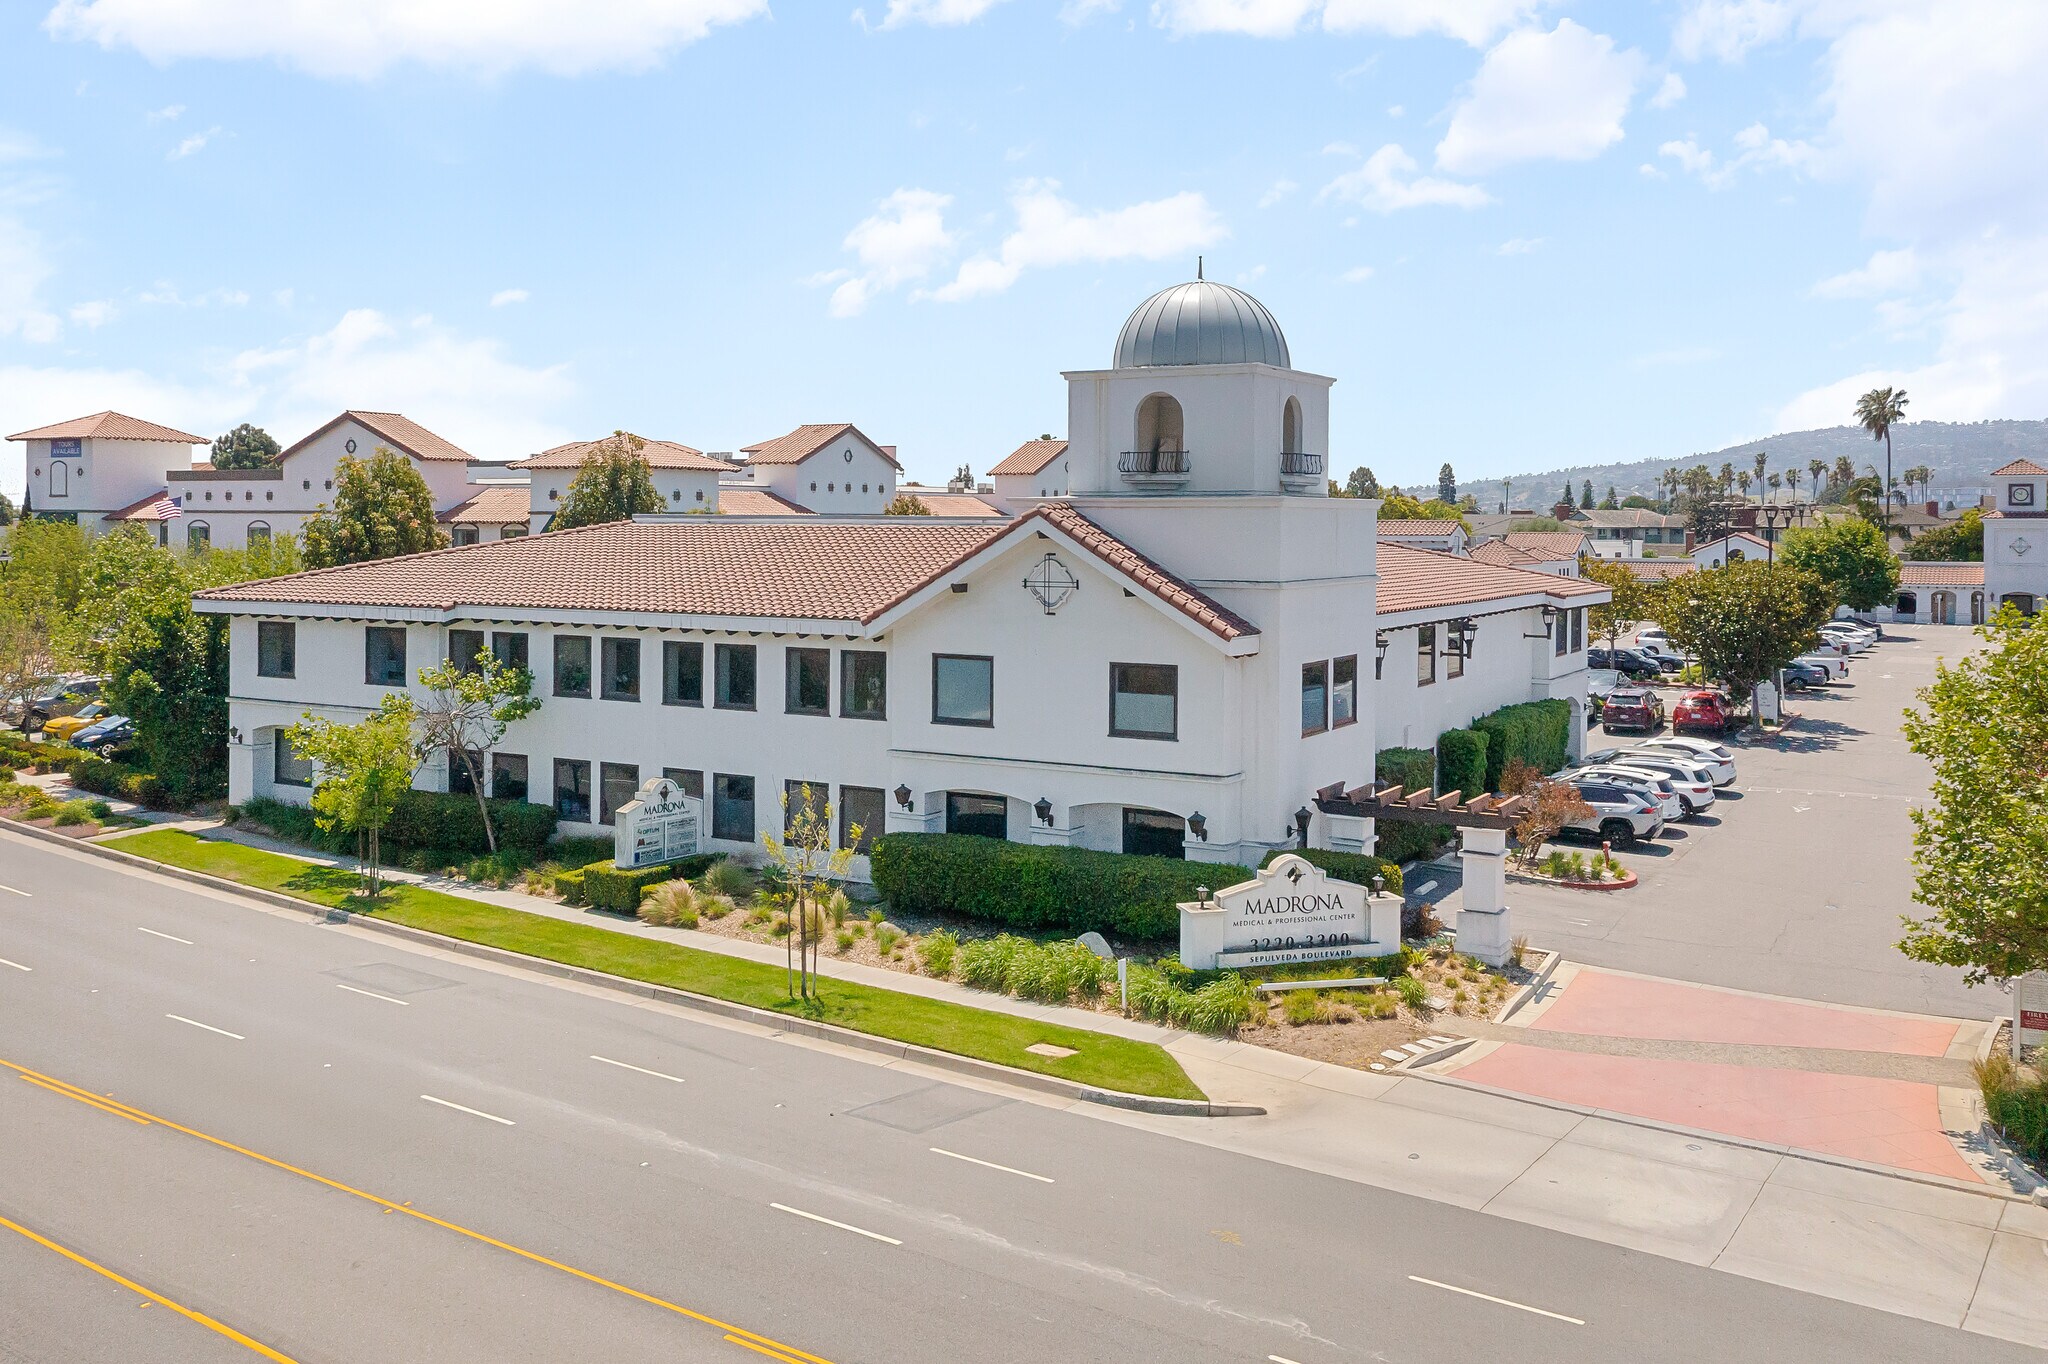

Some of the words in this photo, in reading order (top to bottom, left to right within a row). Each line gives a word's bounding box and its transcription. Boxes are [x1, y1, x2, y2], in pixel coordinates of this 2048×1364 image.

[644, 800, 685, 815] MADRONA
[1244, 893, 1344, 916] MADRONA
[1233, 919, 1265, 927] MEDICAL
[1275, 915, 1327, 924] PROFESSIONAL
[1329, 913, 1356, 921] CENTER
[1250, 953, 1298, 963] SEPULVEDA
[1301, 949, 1352, 960] BOULEVARD
